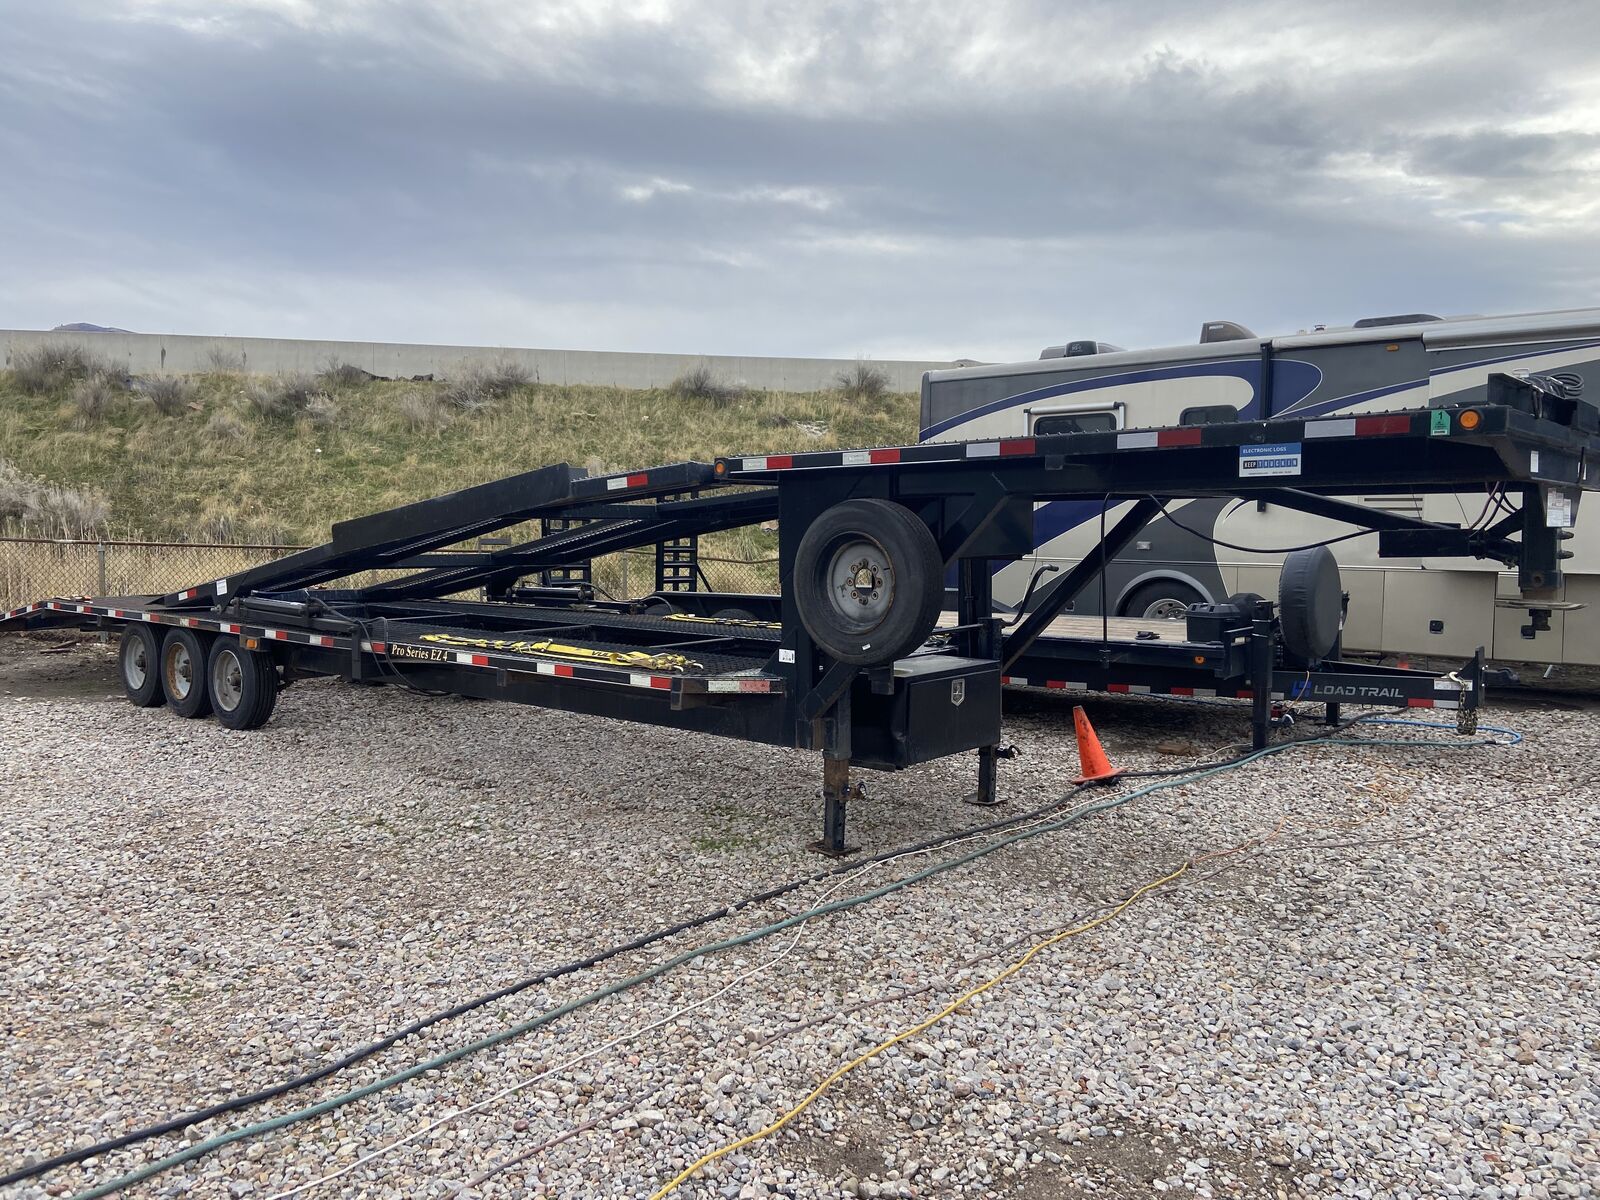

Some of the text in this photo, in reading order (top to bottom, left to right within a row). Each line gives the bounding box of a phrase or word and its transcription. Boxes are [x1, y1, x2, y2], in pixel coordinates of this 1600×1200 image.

[391, 644, 448, 662] Pro Series EZ 4
[1313, 684, 1404, 698] LOAD TRAIL
